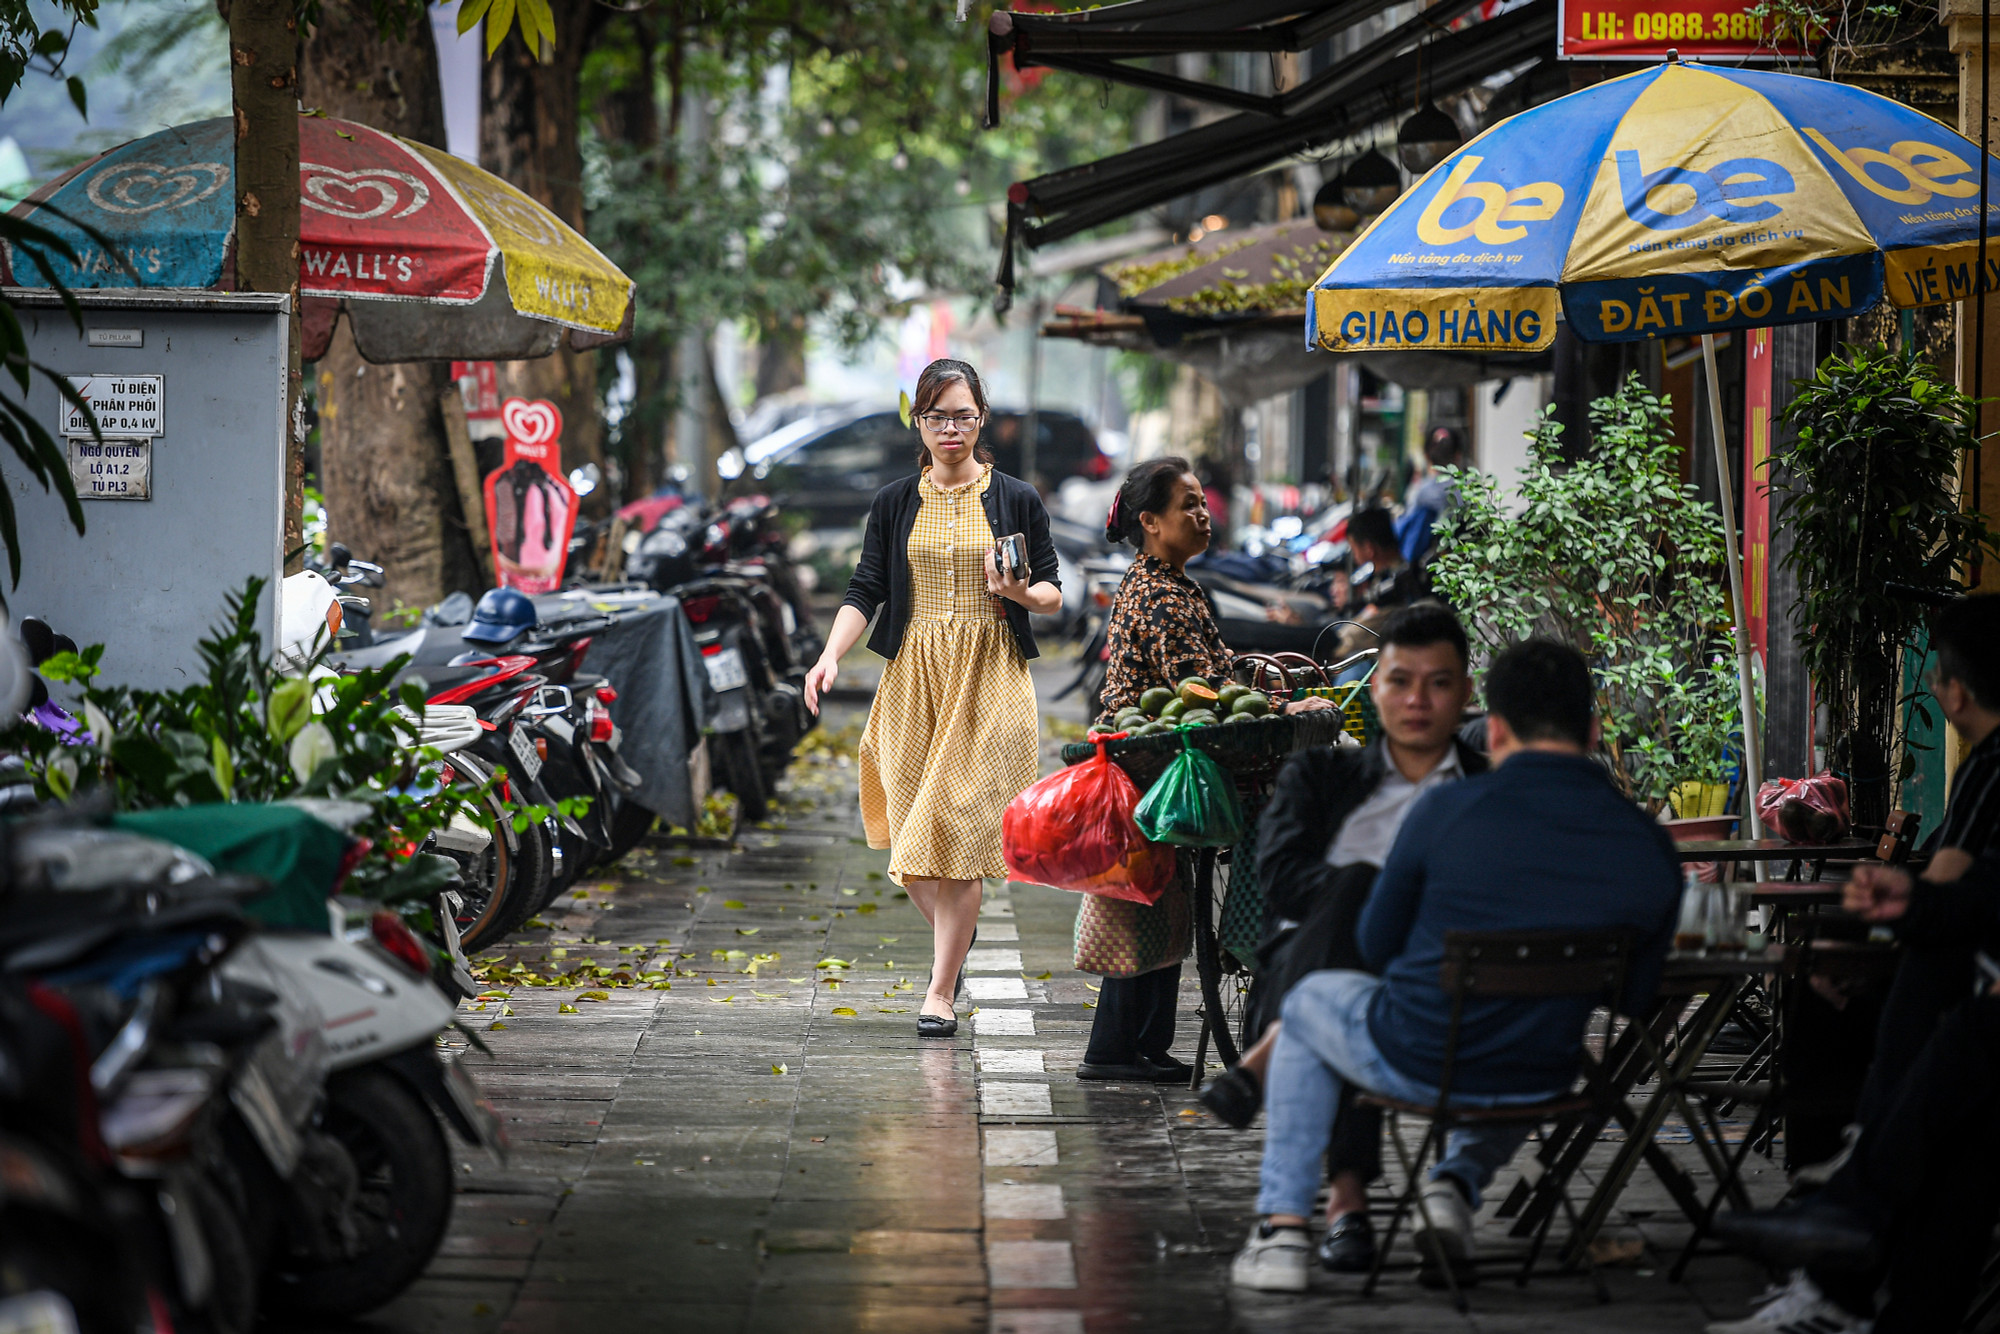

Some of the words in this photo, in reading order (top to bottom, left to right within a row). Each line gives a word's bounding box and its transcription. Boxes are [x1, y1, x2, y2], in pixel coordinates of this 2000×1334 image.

[1582, 12, 1624, 40] LH:
[1800, 127, 1980, 206] be
[1417, 155, 1565, 246] be
[1615, 149, 1796, 231] be
[1712, 234, 1735, 247] đa
[1740, 230, 1778, 246] dịch
[1783, 229, 1804, 241] vụ
[304, 250, 412, 282] WALL'S
[1452, 253, 1472, 264] đa
[1472, 252, 1504, 266] dịch
[1506, 254, 1524, 265] vụ
[534, 275, 591, 311] WALL'S
[1904, 256, 1942, 304] VÉ
[1599, 285, 1690, 339] ĐẶT
[1703, 272, 1773, 323] ĐỒ
[1787, 269, 1852, 315] ĂN
[1340, 310, 1429, 344] GIAO
[1439, 298, 1541, 344] HÀNG
[111, 379, 125, 394] TỦ
[129, 381, 156, 396] ĐIỆN
[93, 398, 125, 411] PHÂN
[129, 397, 156, 411] PHỐI
[101, 415, 117, 428] ÁP
[120, 418, 138, 430] 0,4
[142, 418, 156, 429] kV
[90, 461, 103, 477] LỘ
[106, 464, 129, 475] A1.2
[91, 476, 105, 492] TỦ
[108, 481, 127, 492] PL3
